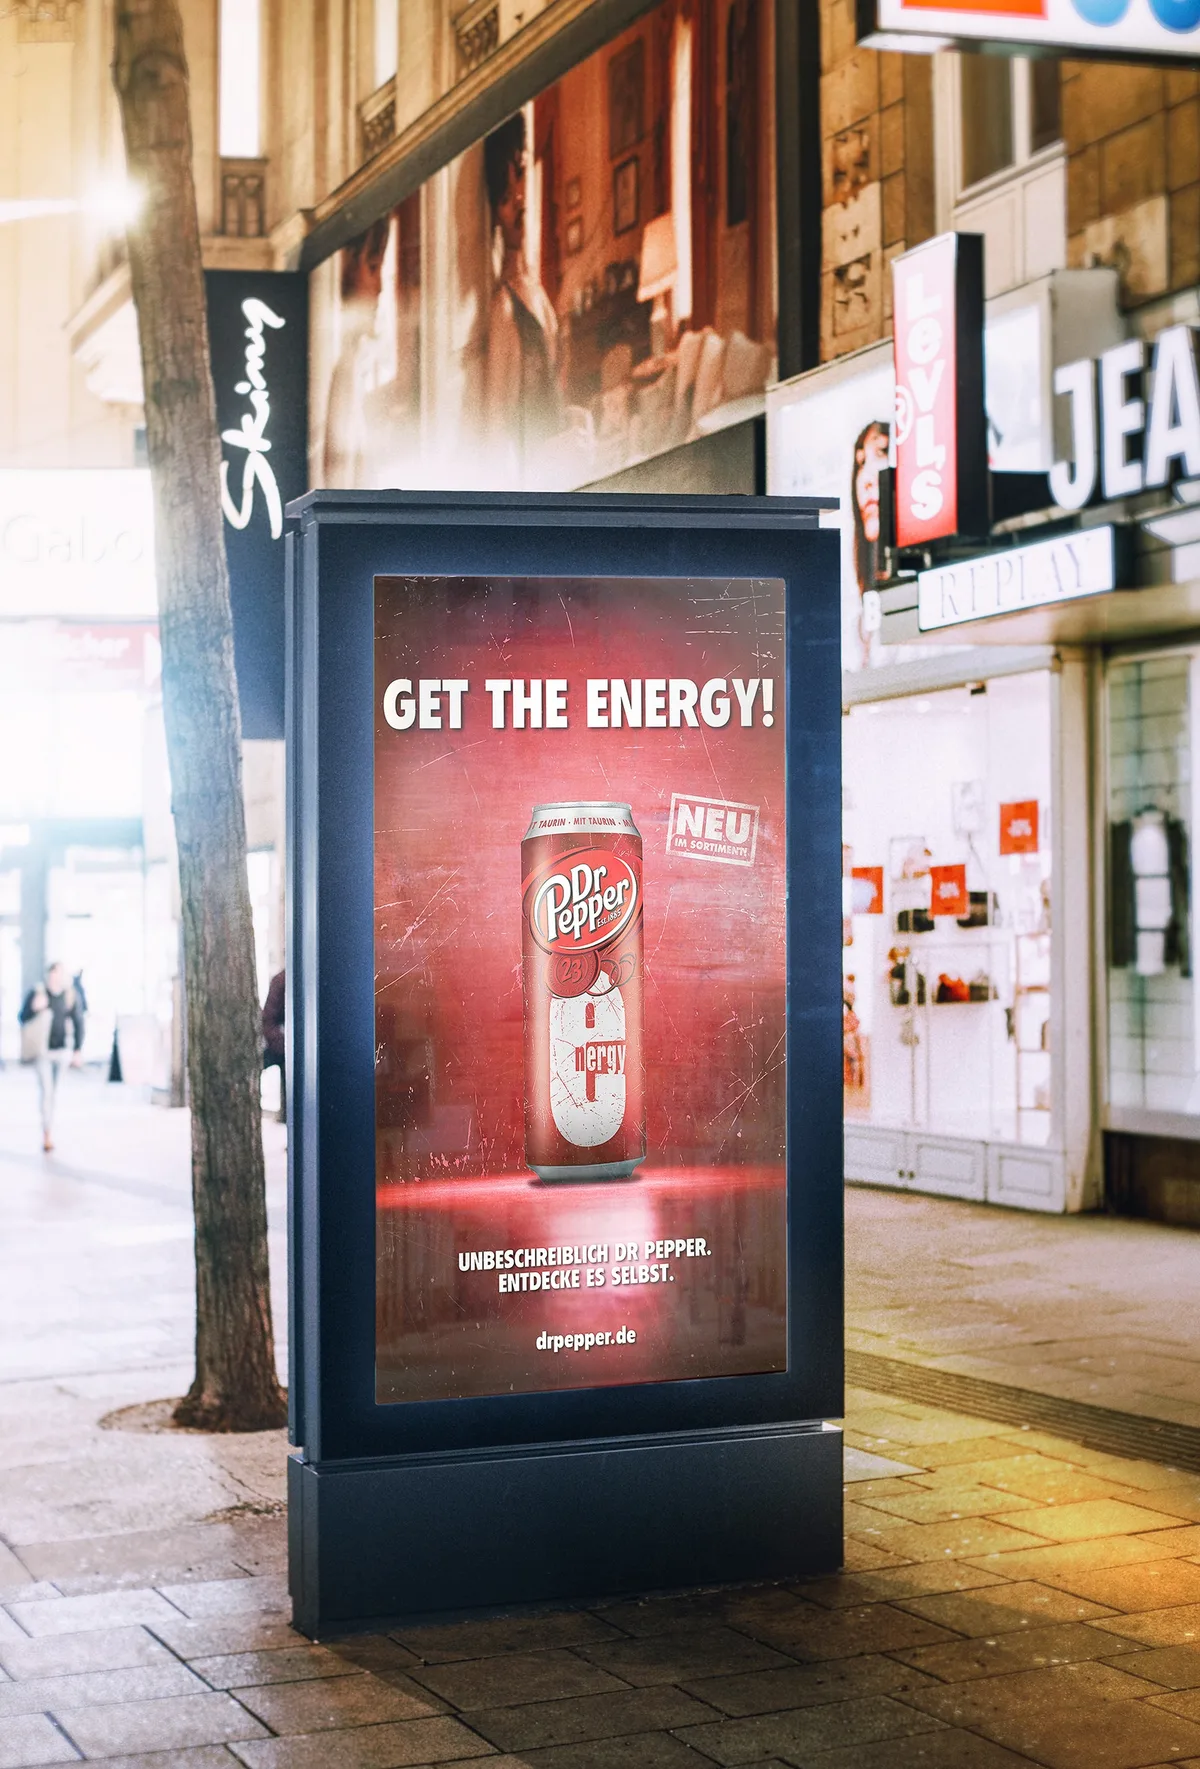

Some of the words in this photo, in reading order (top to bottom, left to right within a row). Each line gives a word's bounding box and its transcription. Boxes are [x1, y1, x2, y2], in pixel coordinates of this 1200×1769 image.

[382, 678, 469, 730] GET
[485, 678, 569, 730] THE
[586, 677, 775, 730] ENERGY!
[538, 818, 567, 829] TAURIN
[573, 817, 588, 826] MIT
[588, 817, 617, 826] TAURIN
[676, 803, 752, 845] NEU
[674, 837, 688, 848] IM
[570, 863, 608, 905] Dr
[534, 873, 630, 943] Pepper
[561, 957, 583, 984] 23
[458, 1243, 609, 1272] UNBESCHREIBLICH
[615, 1242, 639, 1262] DR
[644, 1237, 712, 1260] PEPPER.
[498, 1269, 581, 1293] ENTDECKE
[586, 1266, 605, 1287] ES
[611, 1263, 675, 1286] SELBST.
[535, 1325, 637, 1353] drpepper.de
